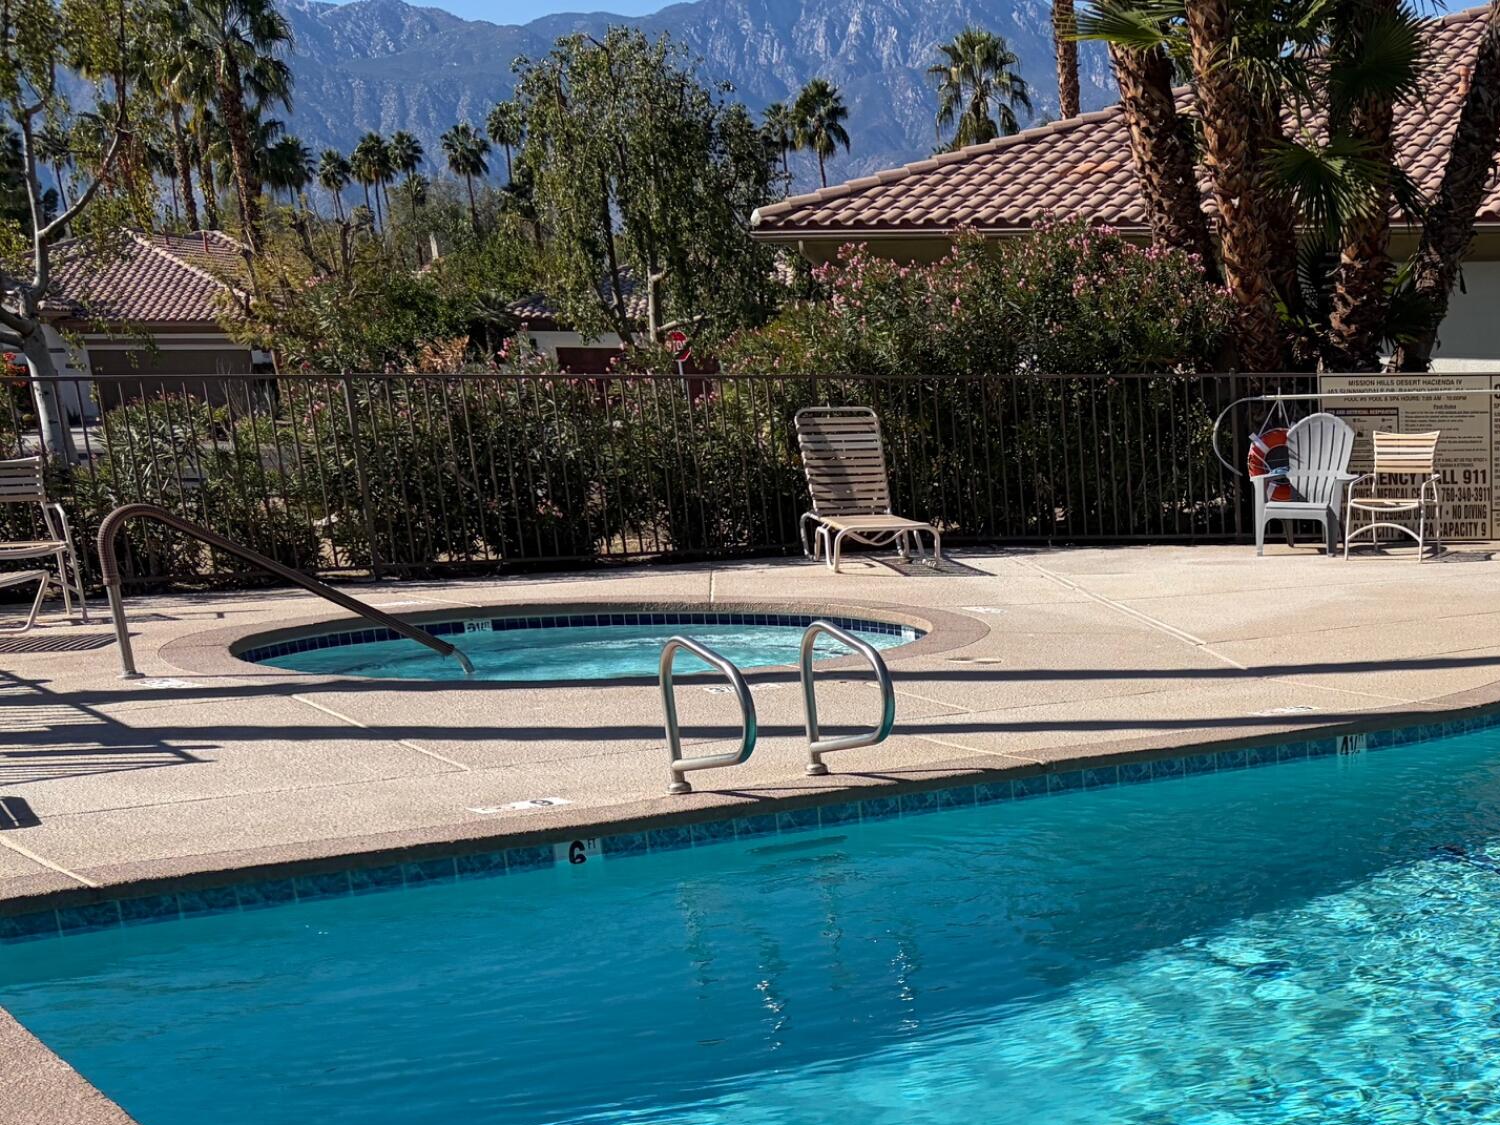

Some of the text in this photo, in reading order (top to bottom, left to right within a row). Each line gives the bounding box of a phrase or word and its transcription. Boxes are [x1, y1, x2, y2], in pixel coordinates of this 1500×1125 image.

[1348, 379, 1375, 387] MISSION
[1463, 469, 1487, 484] 911
[1441, 486, 1491, 503] 760-340-3911
[1452, 504, 1462, 519] NO
[1464, 504, 1487, 519] DIVING
[1480, 522, 1487, 537] 9
[569, 838, 597, 864] 6 FT
